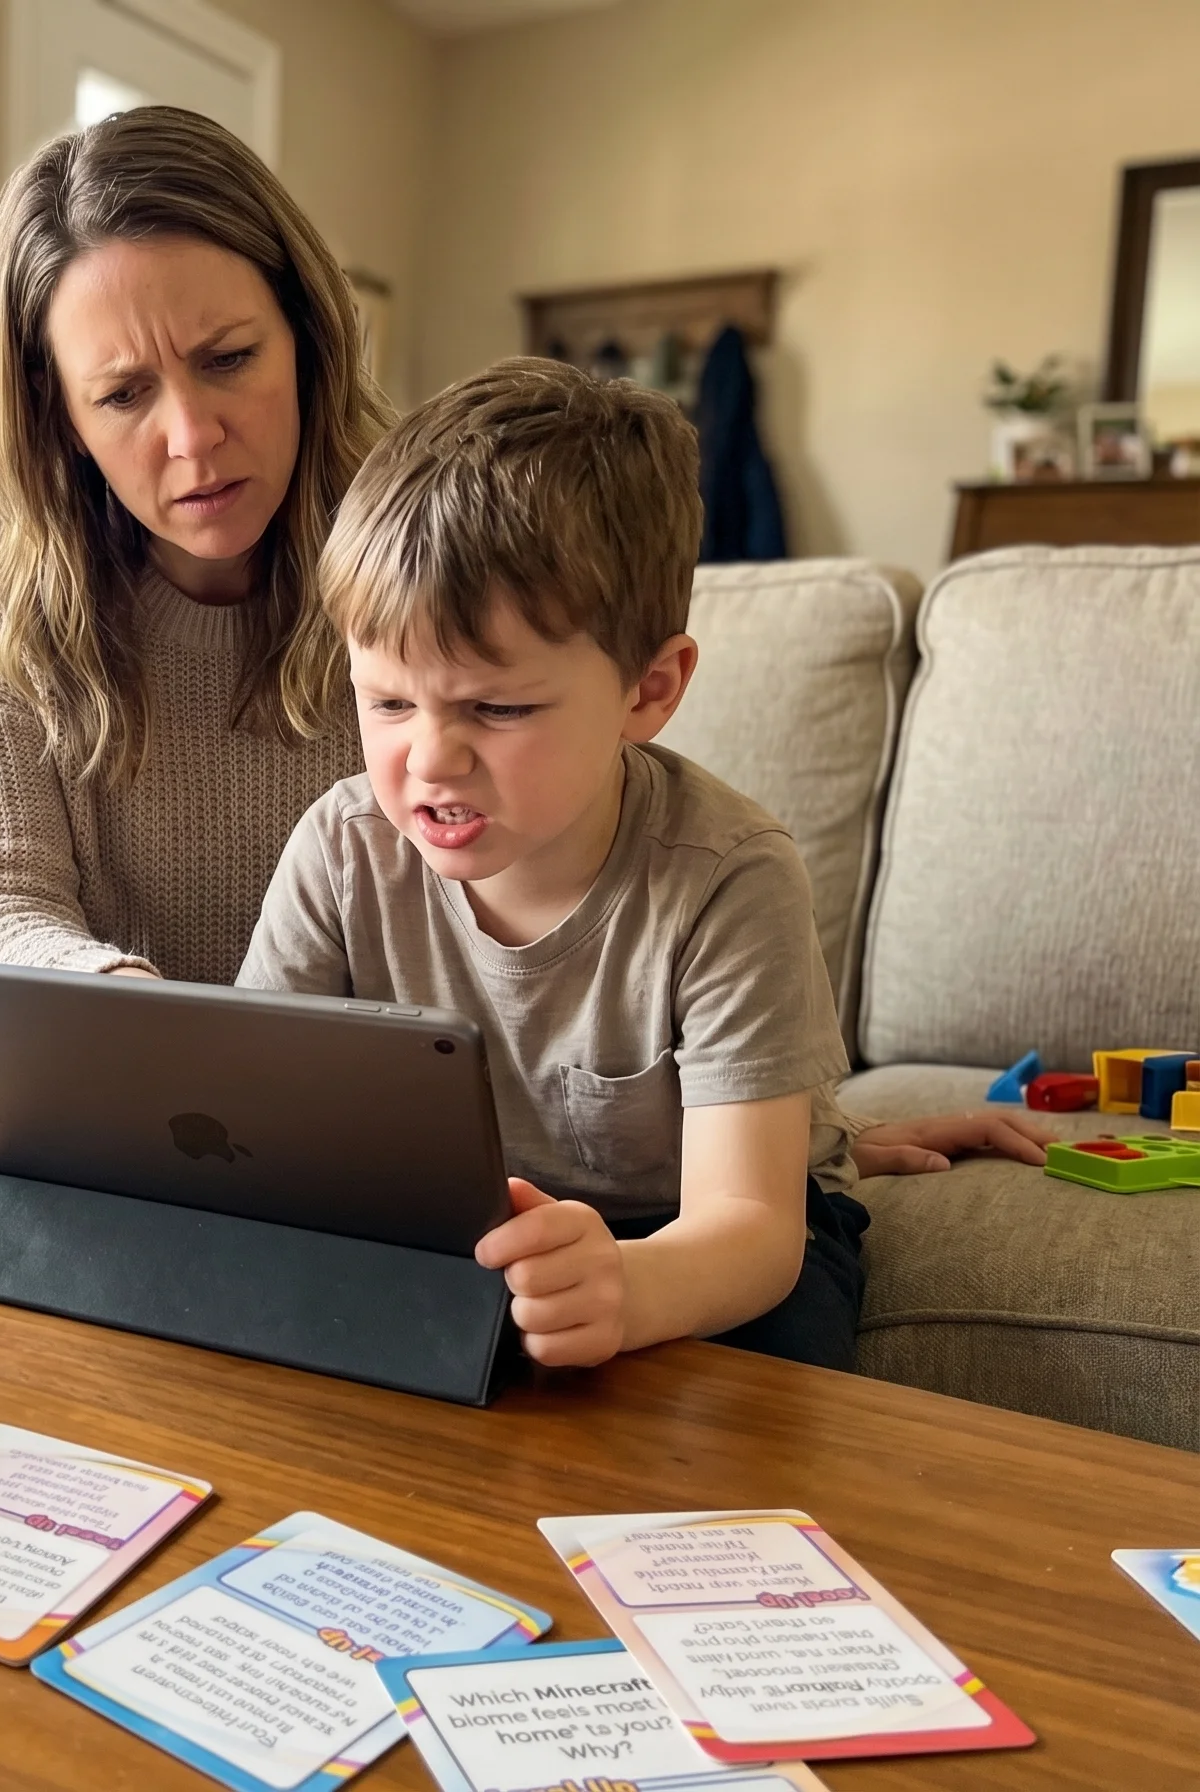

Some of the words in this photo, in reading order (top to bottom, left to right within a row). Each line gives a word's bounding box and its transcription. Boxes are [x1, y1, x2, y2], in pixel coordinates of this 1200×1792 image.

[450, 1688, 530, 1708] Which
[534, 1677, 655, 1701] Minecraft
[448, 1709, 529, 1729] biome
[531, 1703, 591, 1721] feels
[597, 1697, 656, 1715] most
[614, 1715, 674, 1738] you?
[559, 1740, 634, 1761] Why?
